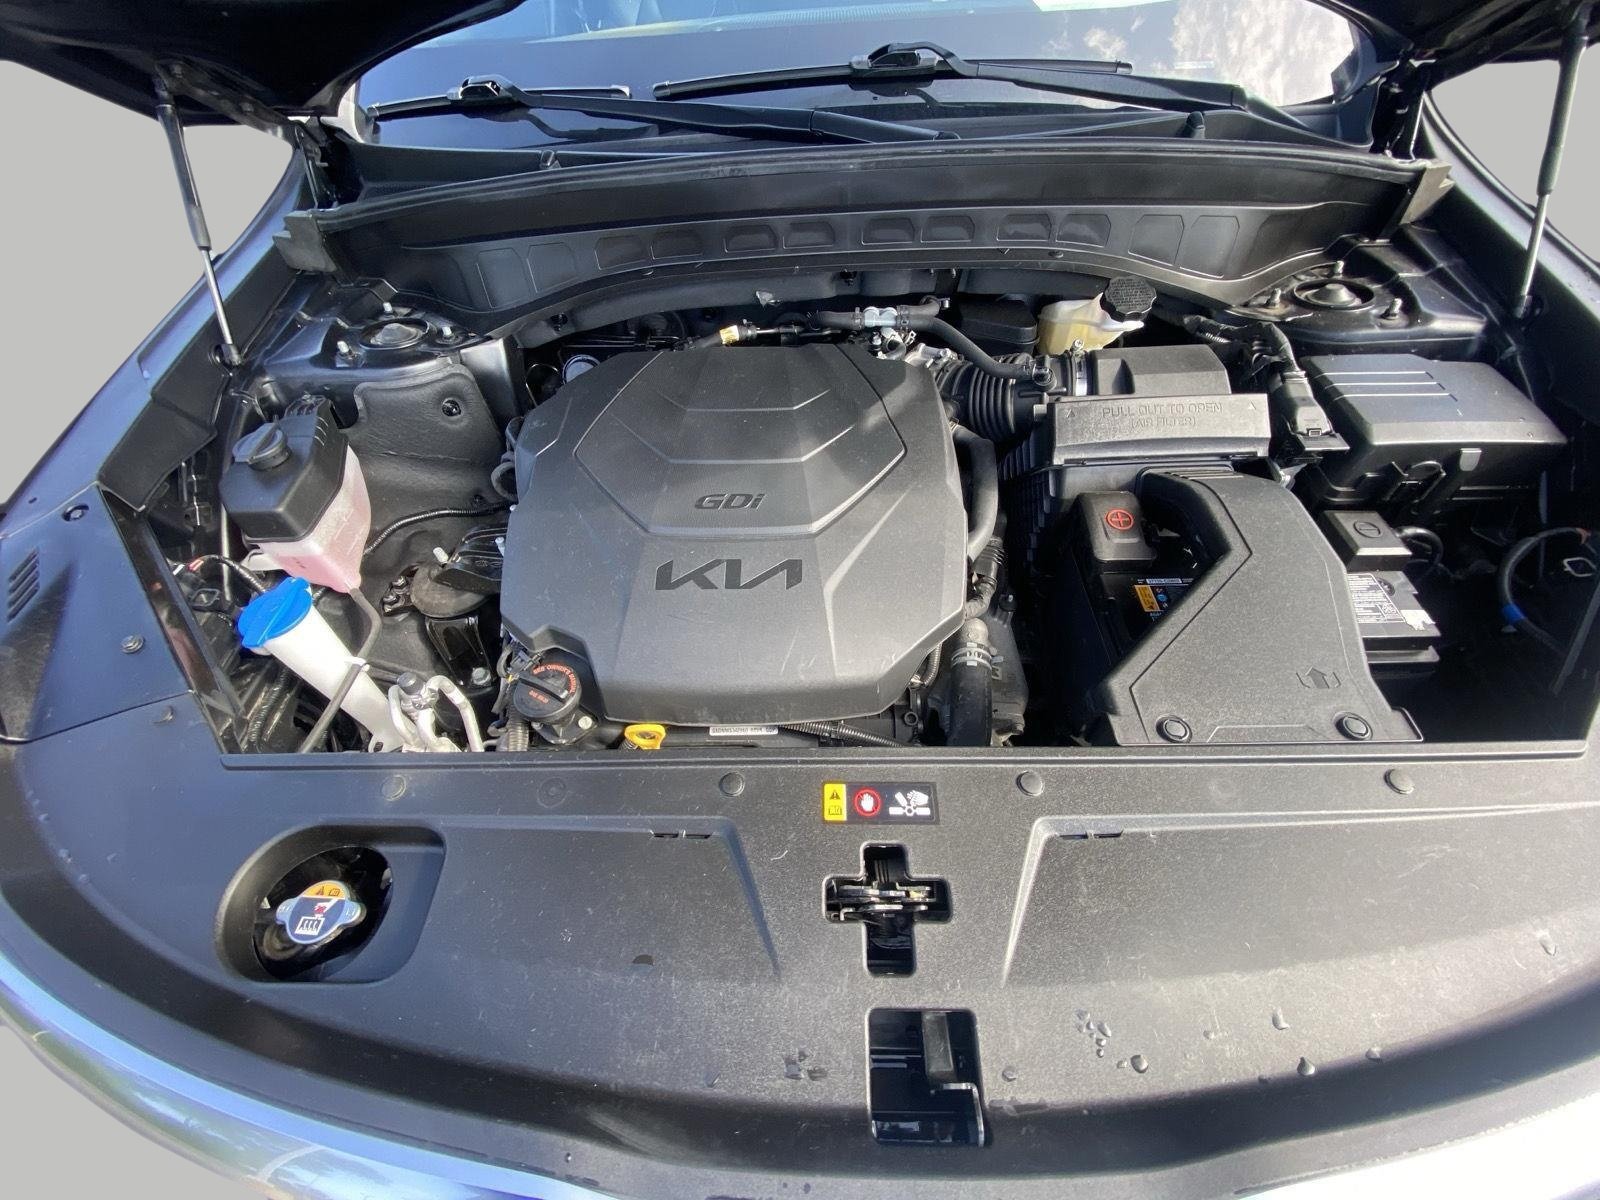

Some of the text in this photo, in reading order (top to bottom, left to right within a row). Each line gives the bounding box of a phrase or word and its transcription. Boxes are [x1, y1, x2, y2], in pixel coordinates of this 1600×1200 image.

[1102, 402, 1223, 418] PULL OUT TO OPEN
[655, 558, 802, 590] KIA
